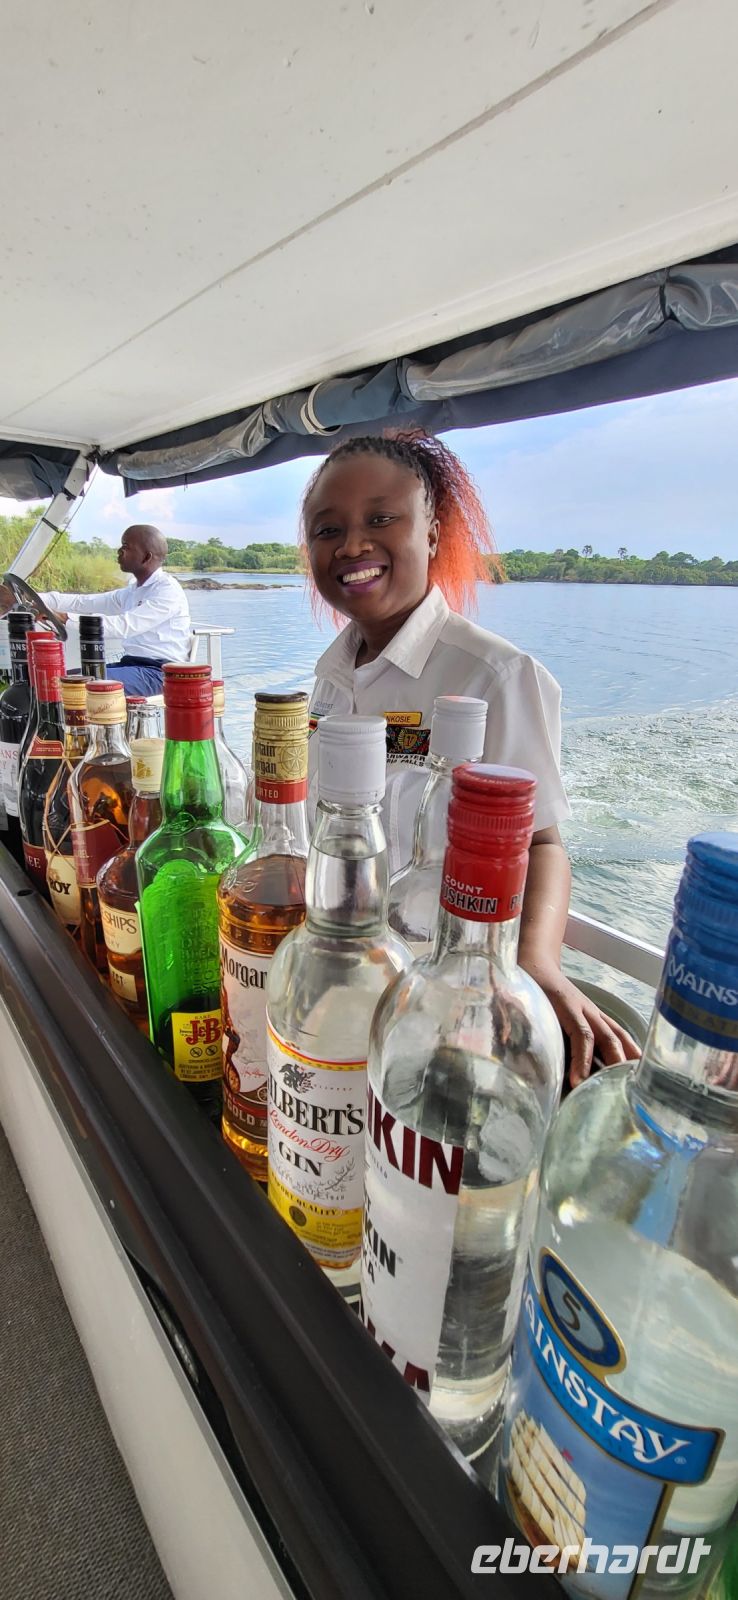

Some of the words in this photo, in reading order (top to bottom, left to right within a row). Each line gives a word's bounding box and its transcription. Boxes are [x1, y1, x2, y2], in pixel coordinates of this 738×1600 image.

[445, 875, 484, 896] COUNT
[103, 910, 137, 934] SHIPS
[667, 953, 738, 1007] MAINS
[185, 1018, 222, 1046] J&B
[268, 1072, 365, 1137] ILBERT'S
[269, 1109, 313, 1150] London
[310, 1137, 352, 1162] Dry
[278, 1140, 323, 1178] GIN
[521, 1282, 693, 1464] AINSTAY
